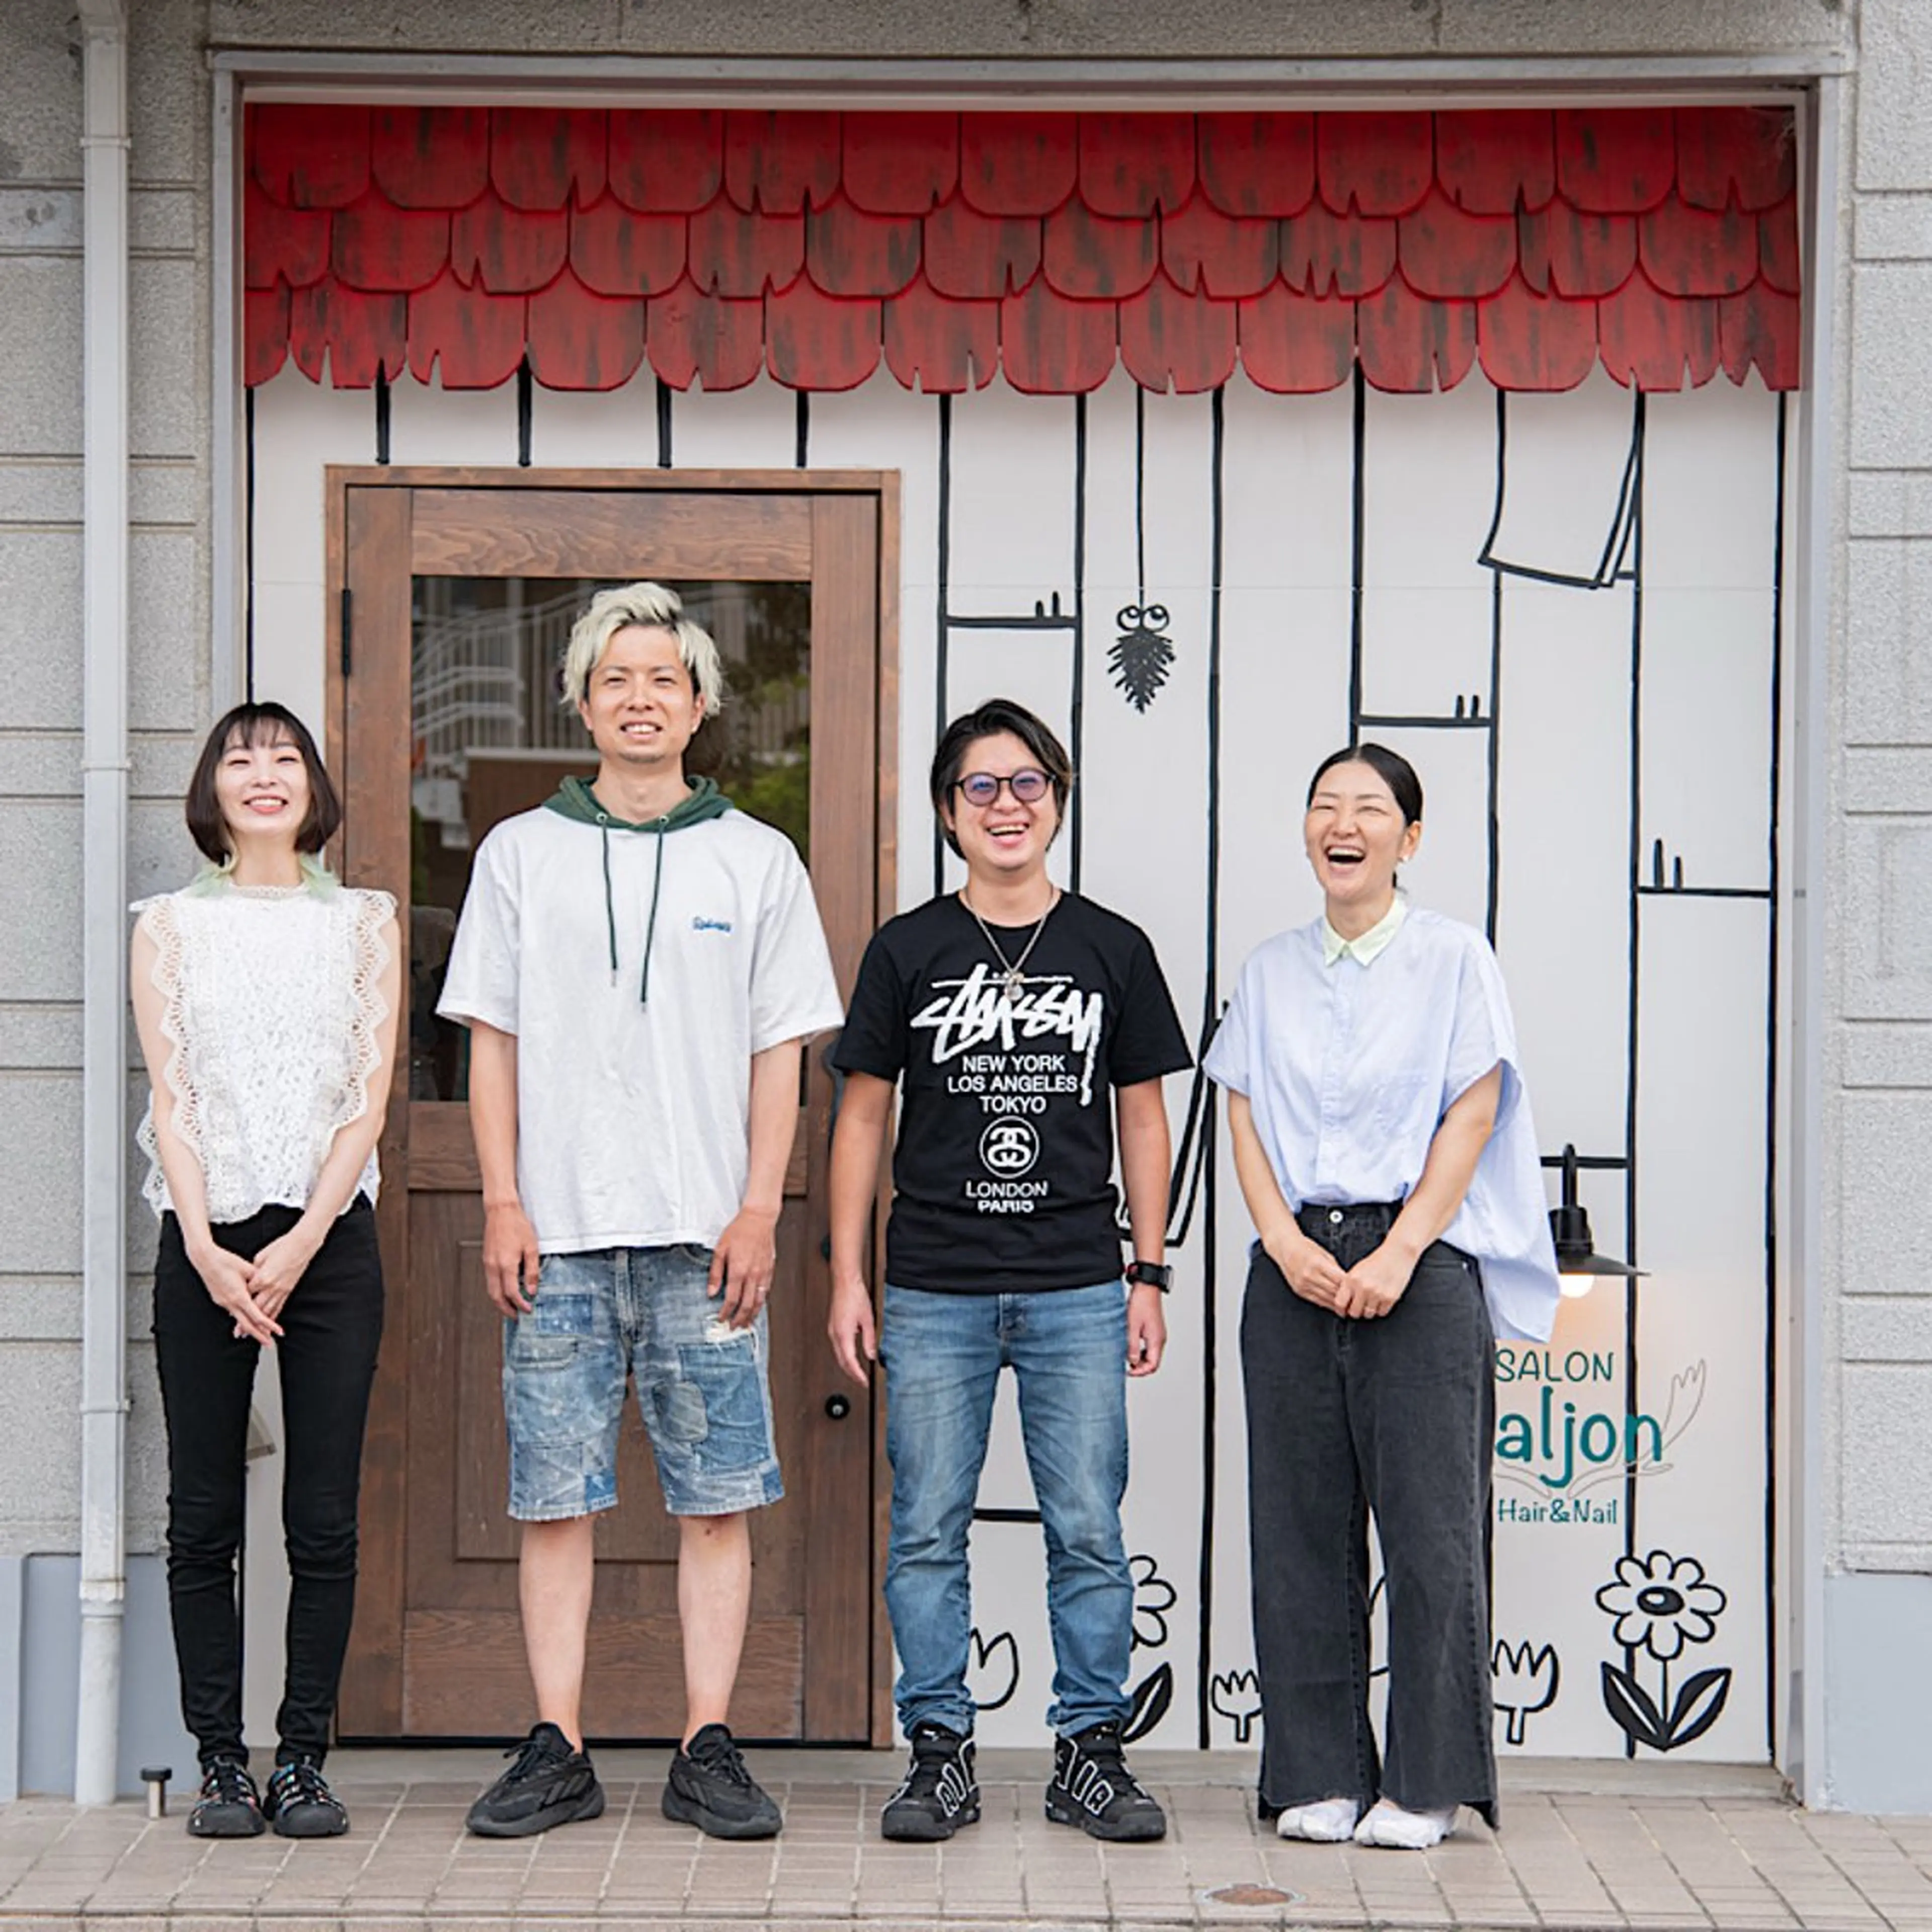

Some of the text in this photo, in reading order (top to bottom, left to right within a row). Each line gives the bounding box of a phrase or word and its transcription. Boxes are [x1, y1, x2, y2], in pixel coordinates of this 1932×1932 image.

[962, 1055, 1065, 1072] NEW YORK
[948, 1075, 1078, 1093] LOS ANGELES
[979, 1095, 1046, 1113] TOKYO
[966, 1181, 1048, 1198] LONDON
[978, 1200, 1034, 1213] PARIS
[1495, 1349, 1614, 1383] SALON
[1495, 1386, 1662, 1488] aljon
[1498, 1499, 1618, 1524] Hair&Nail
